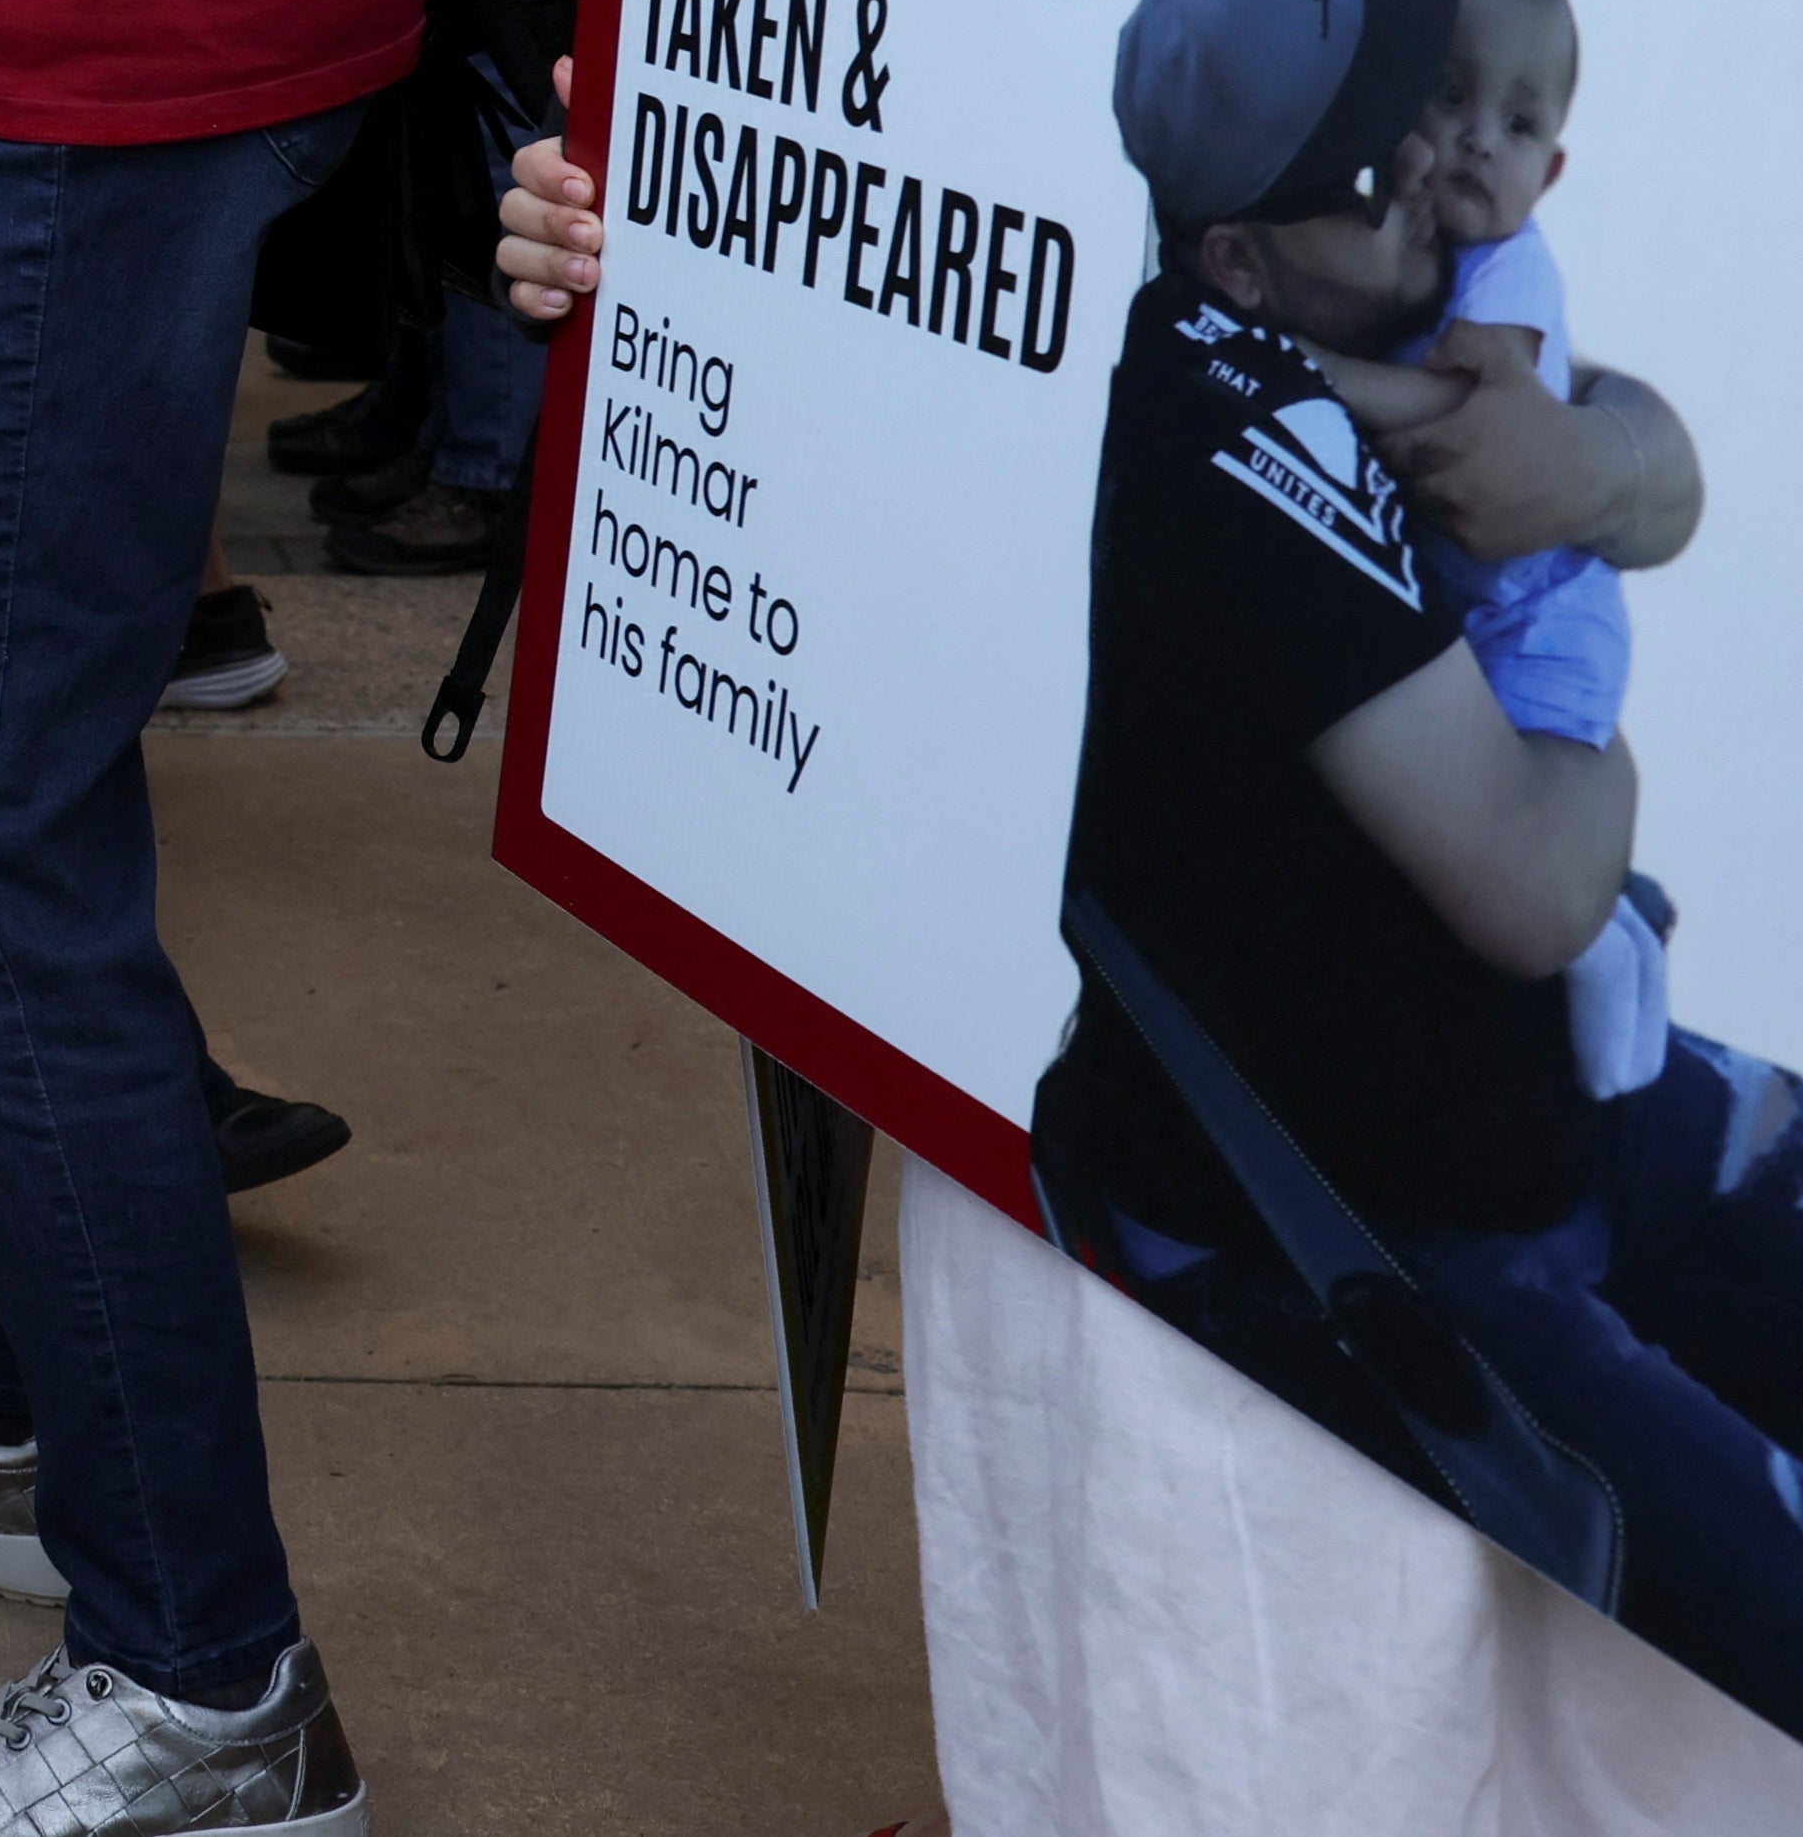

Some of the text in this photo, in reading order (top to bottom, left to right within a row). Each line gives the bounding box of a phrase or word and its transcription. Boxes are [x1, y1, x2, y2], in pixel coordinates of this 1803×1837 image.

[626, 91, 1076, 374] DISAPPEARED
[610, 302, 734, 438] Bring
[1206, 358, 1262, 398] THAT
[601, 397, 758, 529] Kilmar
[1248, 446, 1338, 529] UNITES
[591, 487, 799, 657] home to
[580, 581, 821, 795] his family
